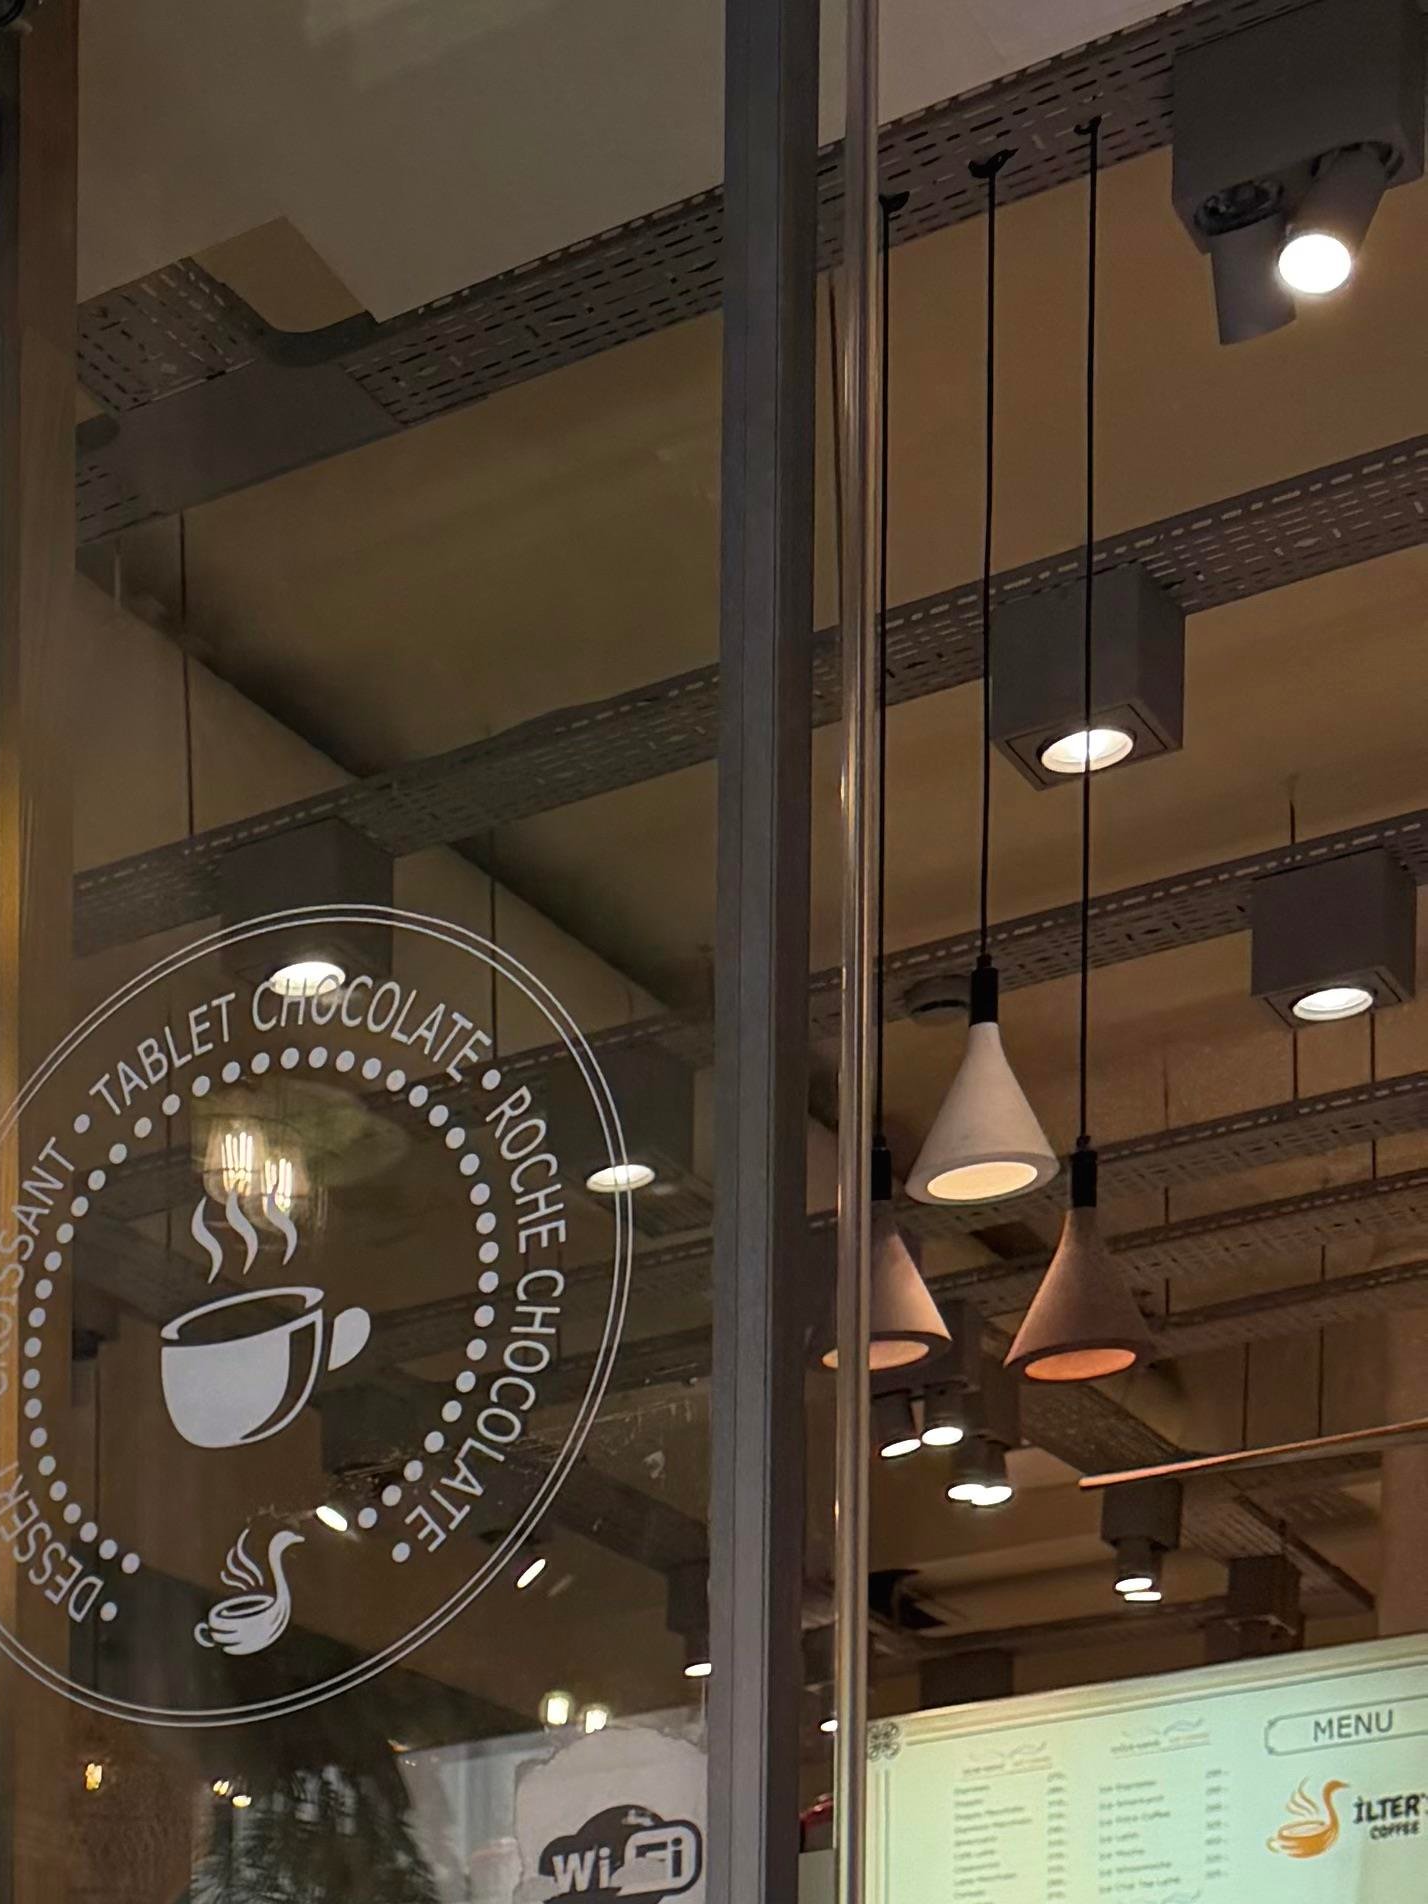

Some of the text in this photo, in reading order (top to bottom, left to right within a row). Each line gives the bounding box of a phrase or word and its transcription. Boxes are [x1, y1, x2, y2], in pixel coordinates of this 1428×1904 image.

[89, 974, 493, 1116] TABLET CHOCOLATE
[404, 1086, 566, 1553] ROCHE CHOCOLATE
[1312, 1709, 1394, 1743] MENU
[1352, 1791, 1428, 1825] İLTER'
[1369, 1820, 1420, 1841] COFFEE
